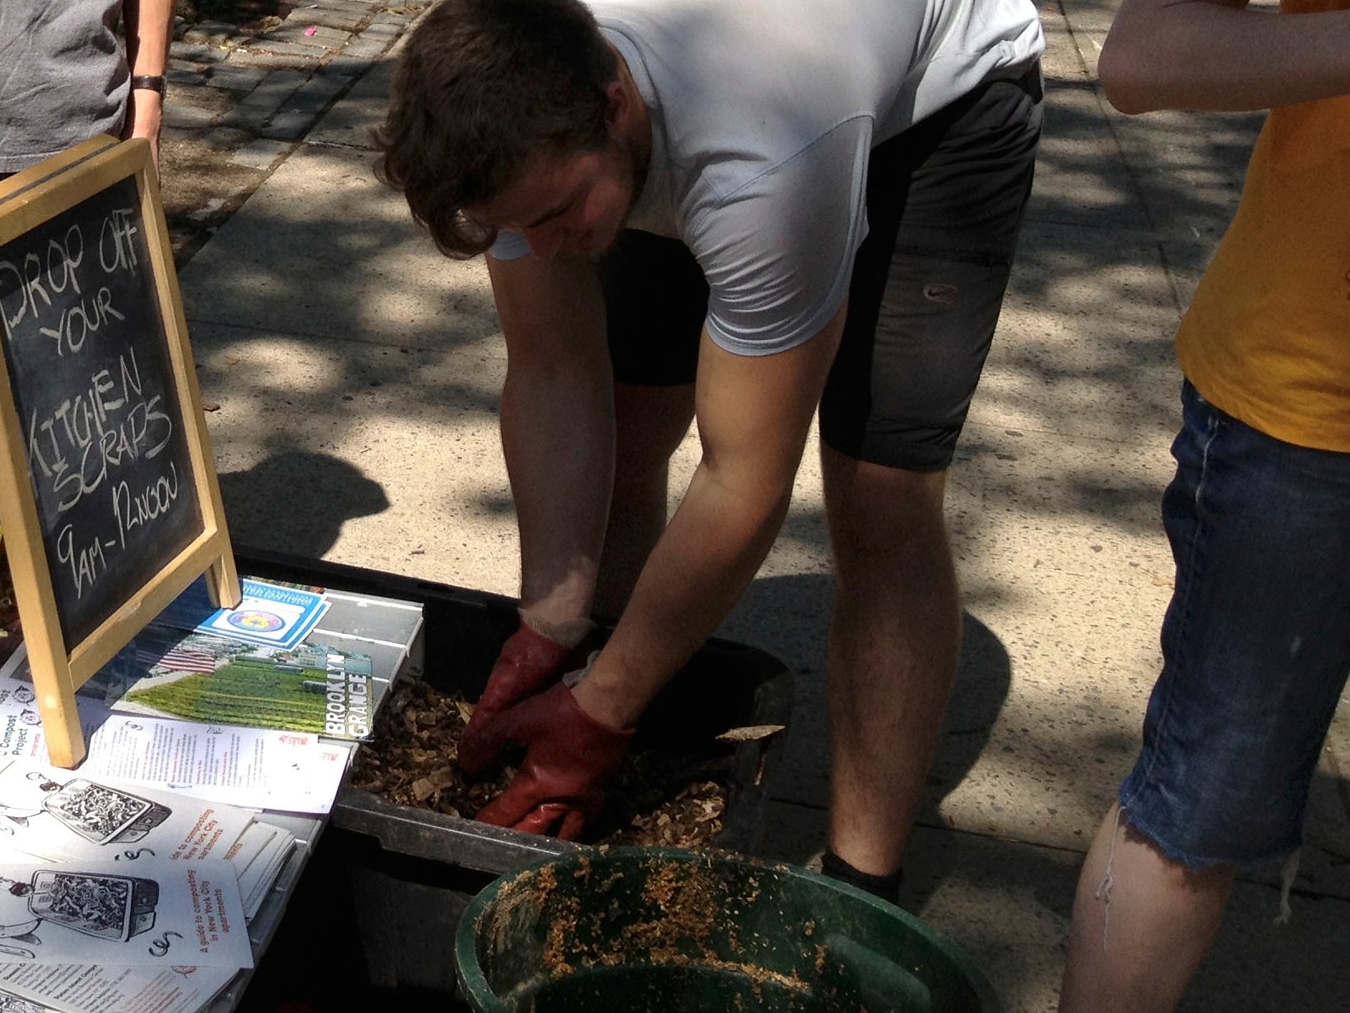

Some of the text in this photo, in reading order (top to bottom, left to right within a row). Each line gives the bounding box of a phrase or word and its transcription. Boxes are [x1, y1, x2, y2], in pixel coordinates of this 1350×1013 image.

[39, 287, 126, 357] YOUR
[28, 346, 142, 477] KITCHEN
[52, 394, 173, 513] SCRAPS
[325, 653, 346, 735] BROOKLYN
[347, 673, 369, 738] GRANGE
[0, 714, 18, 749] Compost
[11, 727, 28, 756] Project
[193, 830, 208, 847] York
[187, 869, 201, 914] composting
[201, 880, 211, 896] City
[202, 896, 213, 915] York
[195, 915, 203, 925] to
[207, 916, 217, 933] New
[214, 888, 231, 934] apartments
[195, 923, 210, 947] guide
